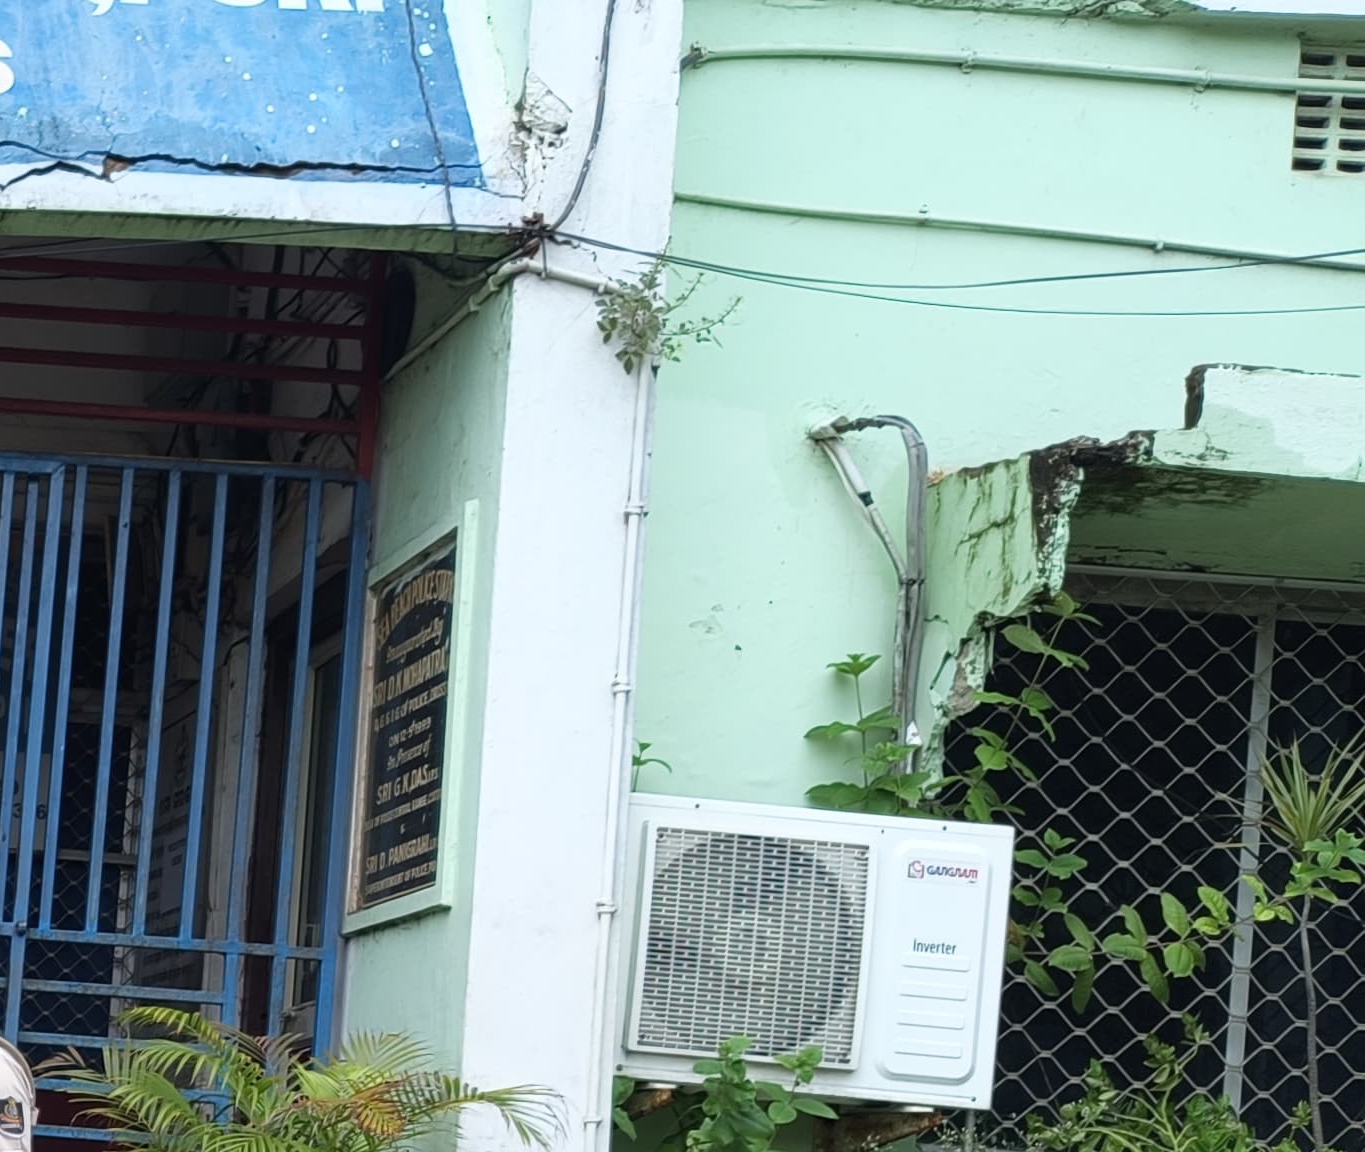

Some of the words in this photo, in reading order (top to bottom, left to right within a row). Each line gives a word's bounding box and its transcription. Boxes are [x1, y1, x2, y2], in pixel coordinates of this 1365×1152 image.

[372, 680, 386, 708] SRI
[376, 781, 391, 804] SRI
[365, 855, 377, 874] SRI
[913, 937, 957, 955] Inverter
